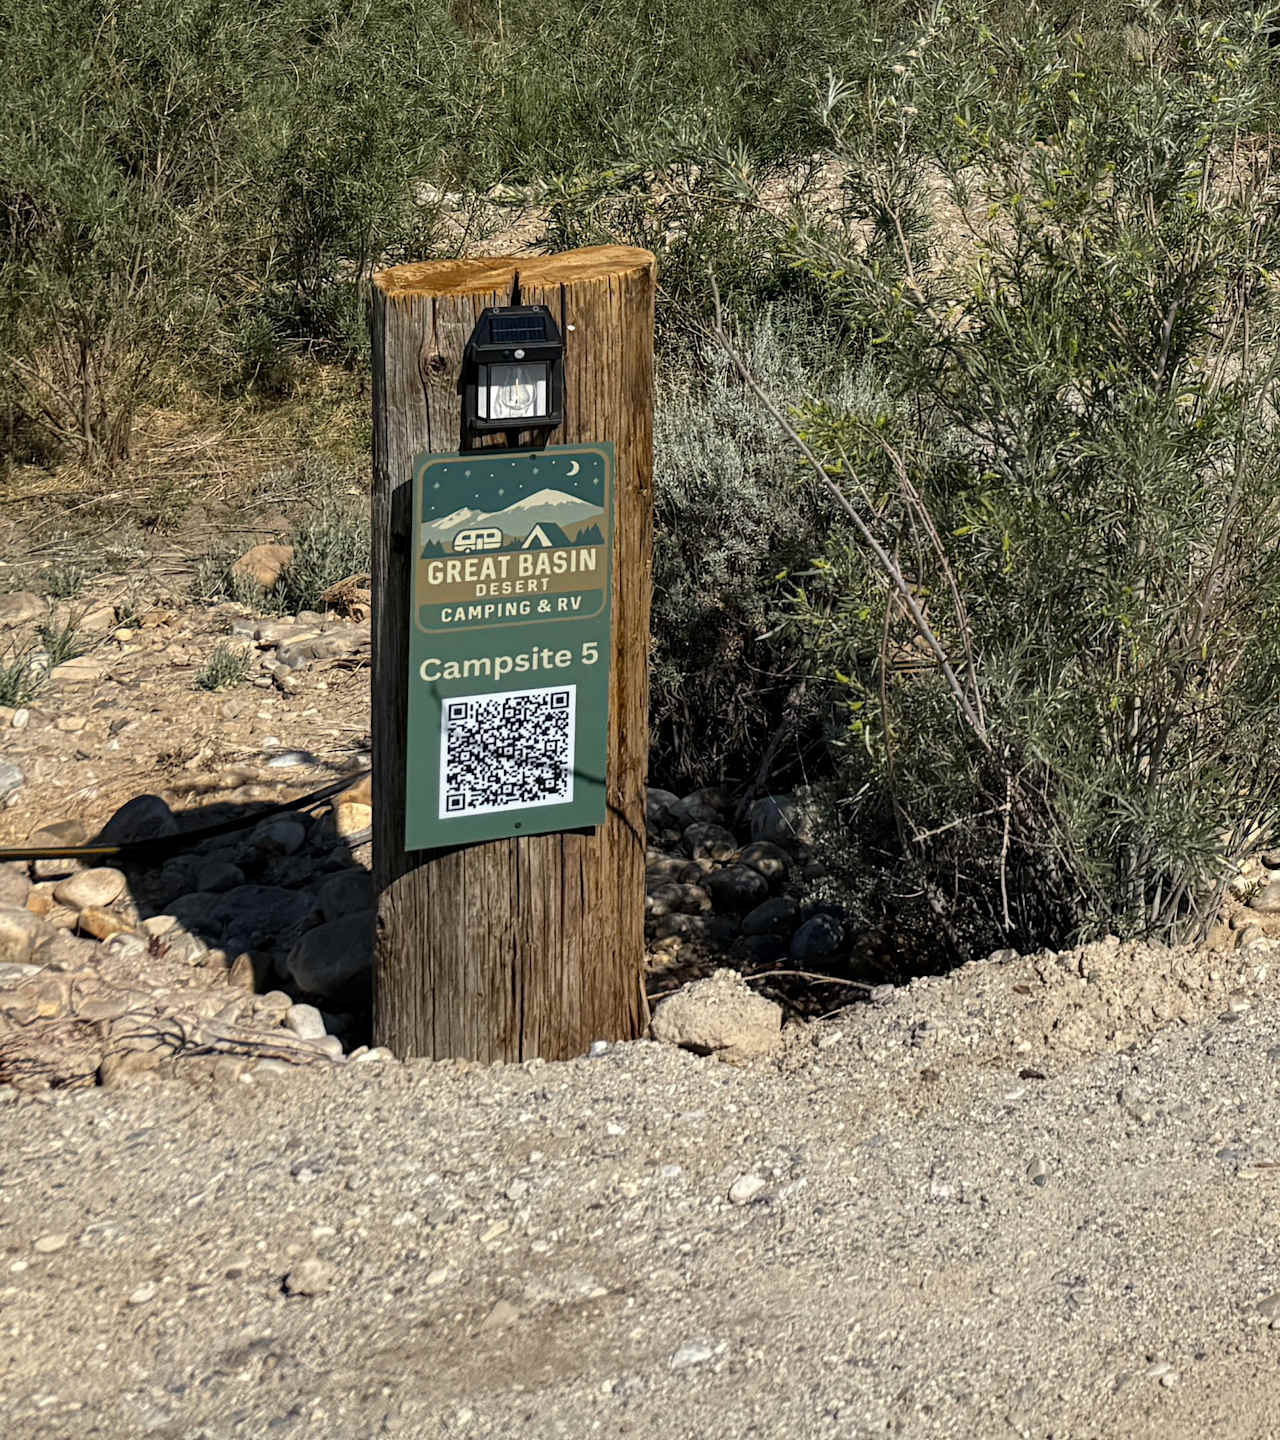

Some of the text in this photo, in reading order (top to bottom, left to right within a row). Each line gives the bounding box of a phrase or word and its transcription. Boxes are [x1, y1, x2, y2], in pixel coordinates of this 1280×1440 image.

[427, 547, 597, 585] GREAT BASIN
[475, 577, 550, 597] DESERT
[440, 595, 582, 623] CAMPING & RV
[419, 641, 599, 682] Campsite 5
